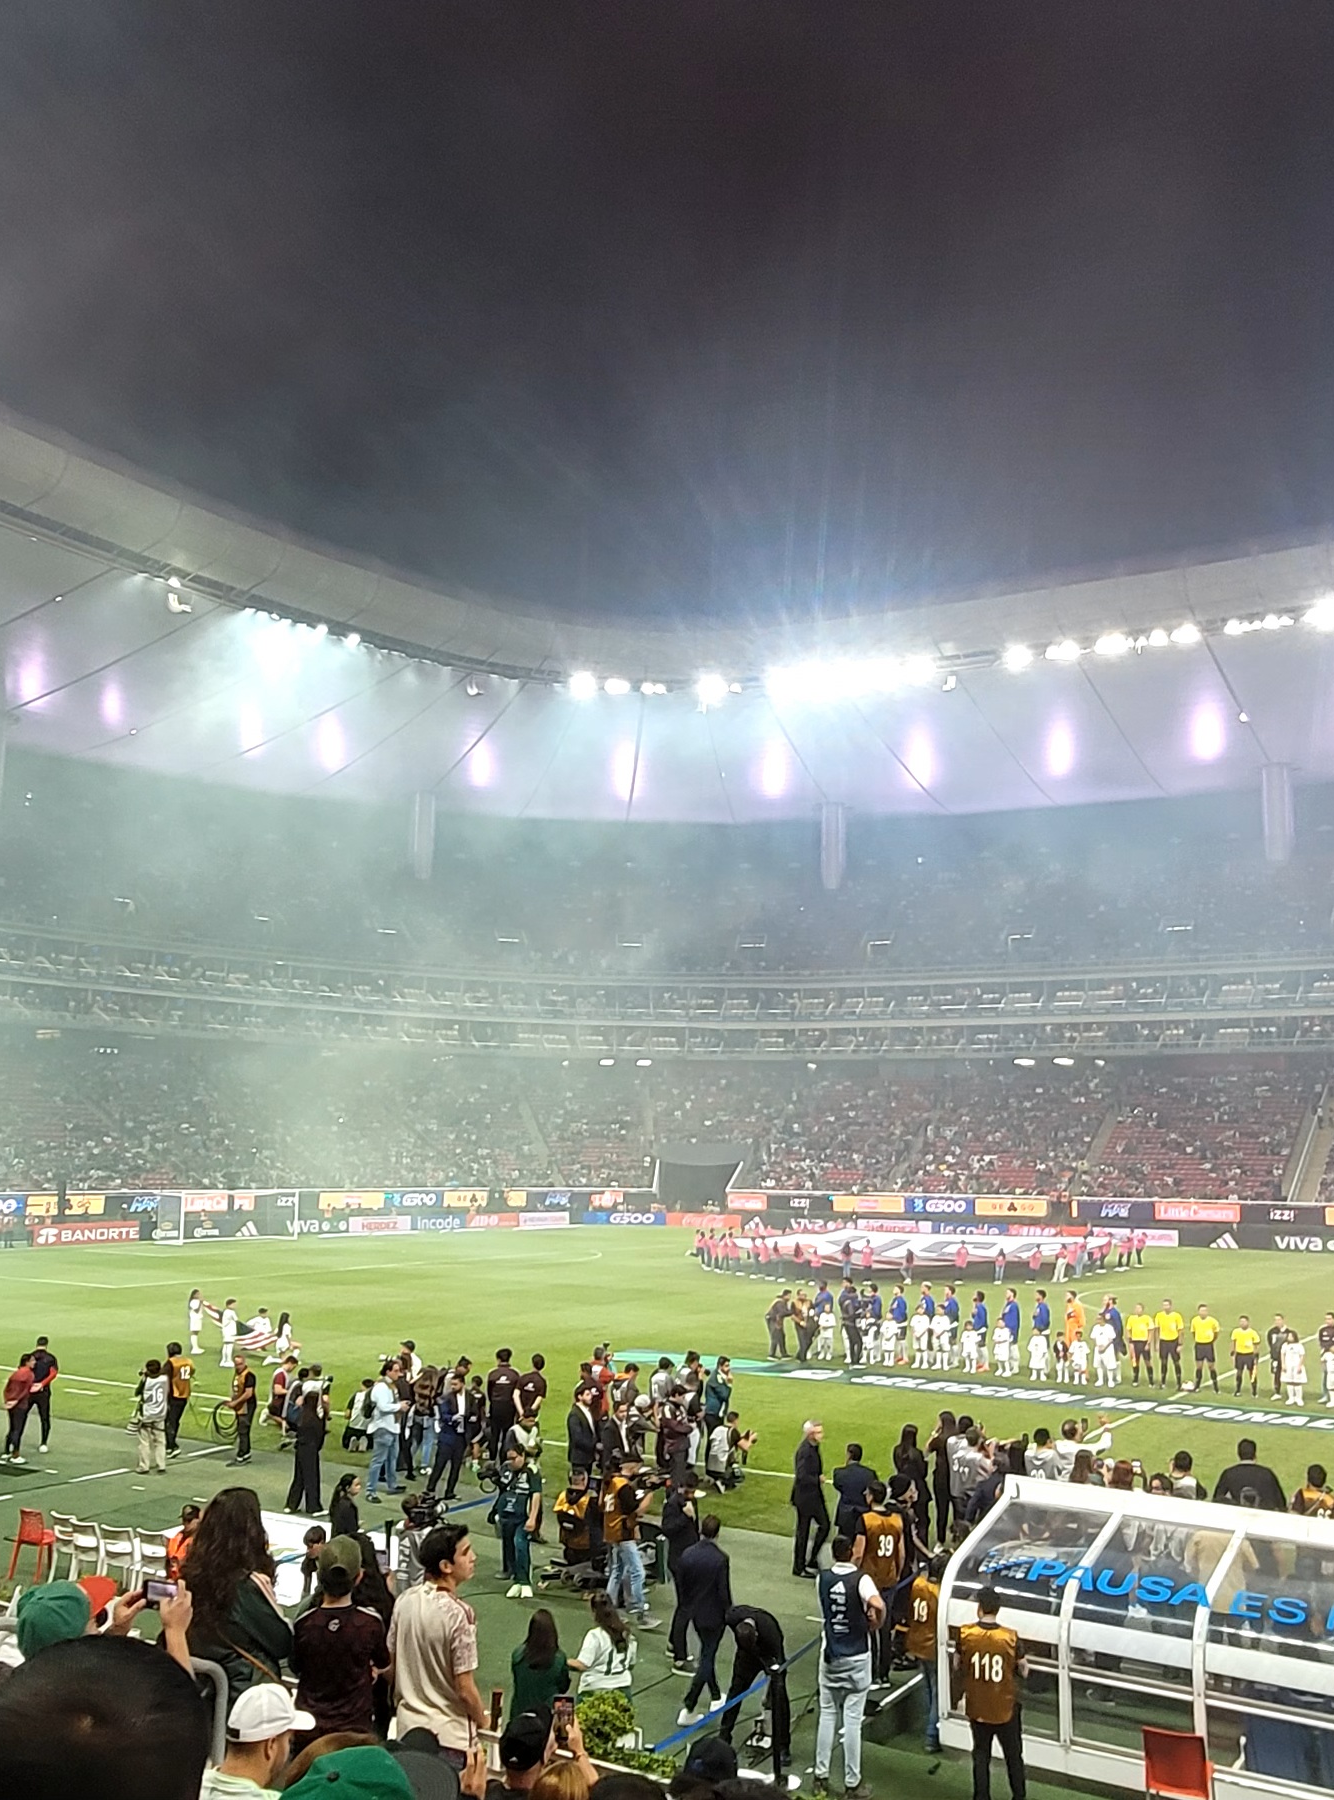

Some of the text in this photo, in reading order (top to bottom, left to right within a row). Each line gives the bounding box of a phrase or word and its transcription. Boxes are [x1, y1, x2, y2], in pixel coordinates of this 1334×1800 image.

[925, 1198, 967, 1214] G500
[417, 1215, 460, 1230] incode
[609, 1212, 655, 1224] G500
[60, 1227, 140, 1242] BANORTE
[179, 1365, 191, 1380] 12
[877, 1534, 894, 1558] 39
[1025, 1558, 1212, 1608] PAUSA
[1228, 1590, 1308, 1626] ES
[912, 1597, 928, 1622] 19
[970, 1650, 1003, 1683] 118
